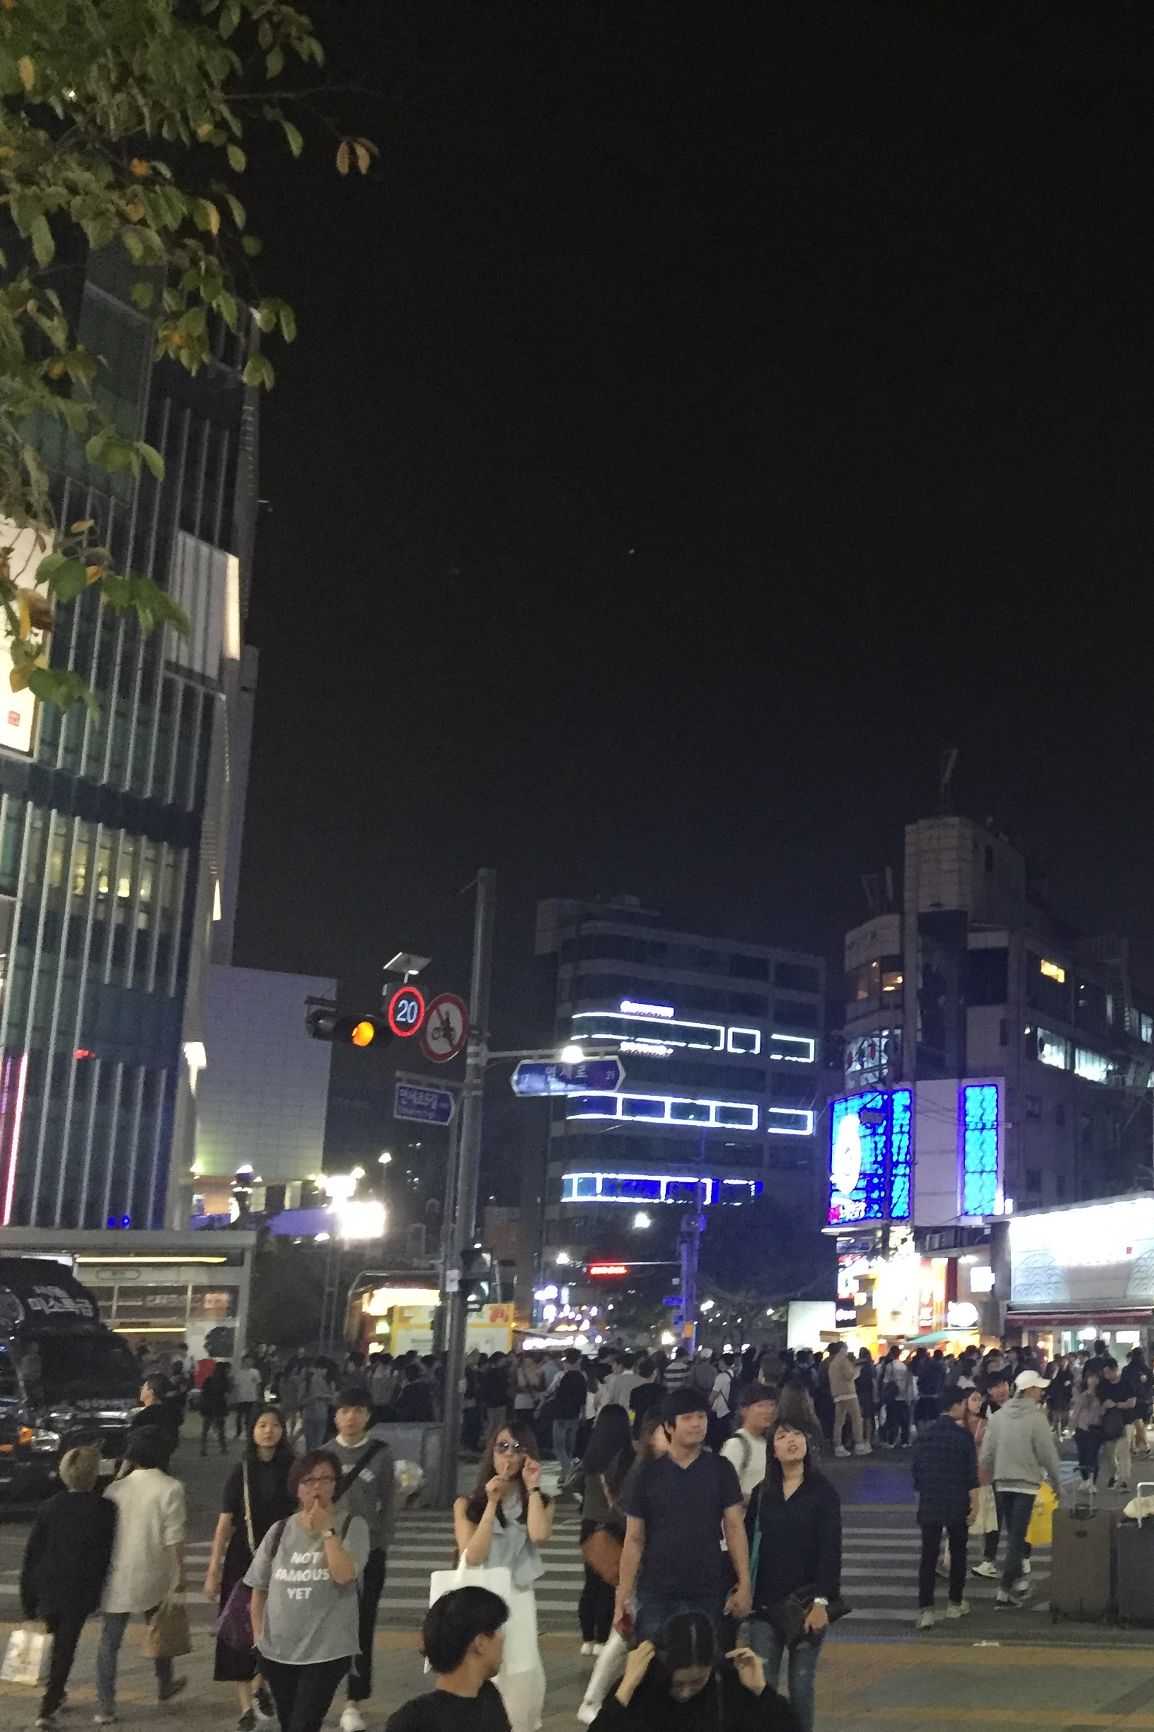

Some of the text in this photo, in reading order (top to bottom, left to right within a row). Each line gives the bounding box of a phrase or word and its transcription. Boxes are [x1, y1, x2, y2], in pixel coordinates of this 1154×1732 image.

[396, 1000, 418, 1024] 20
[290, 1551, 322, 1564] NOT
[287, 1587, 312, 1599] YET
